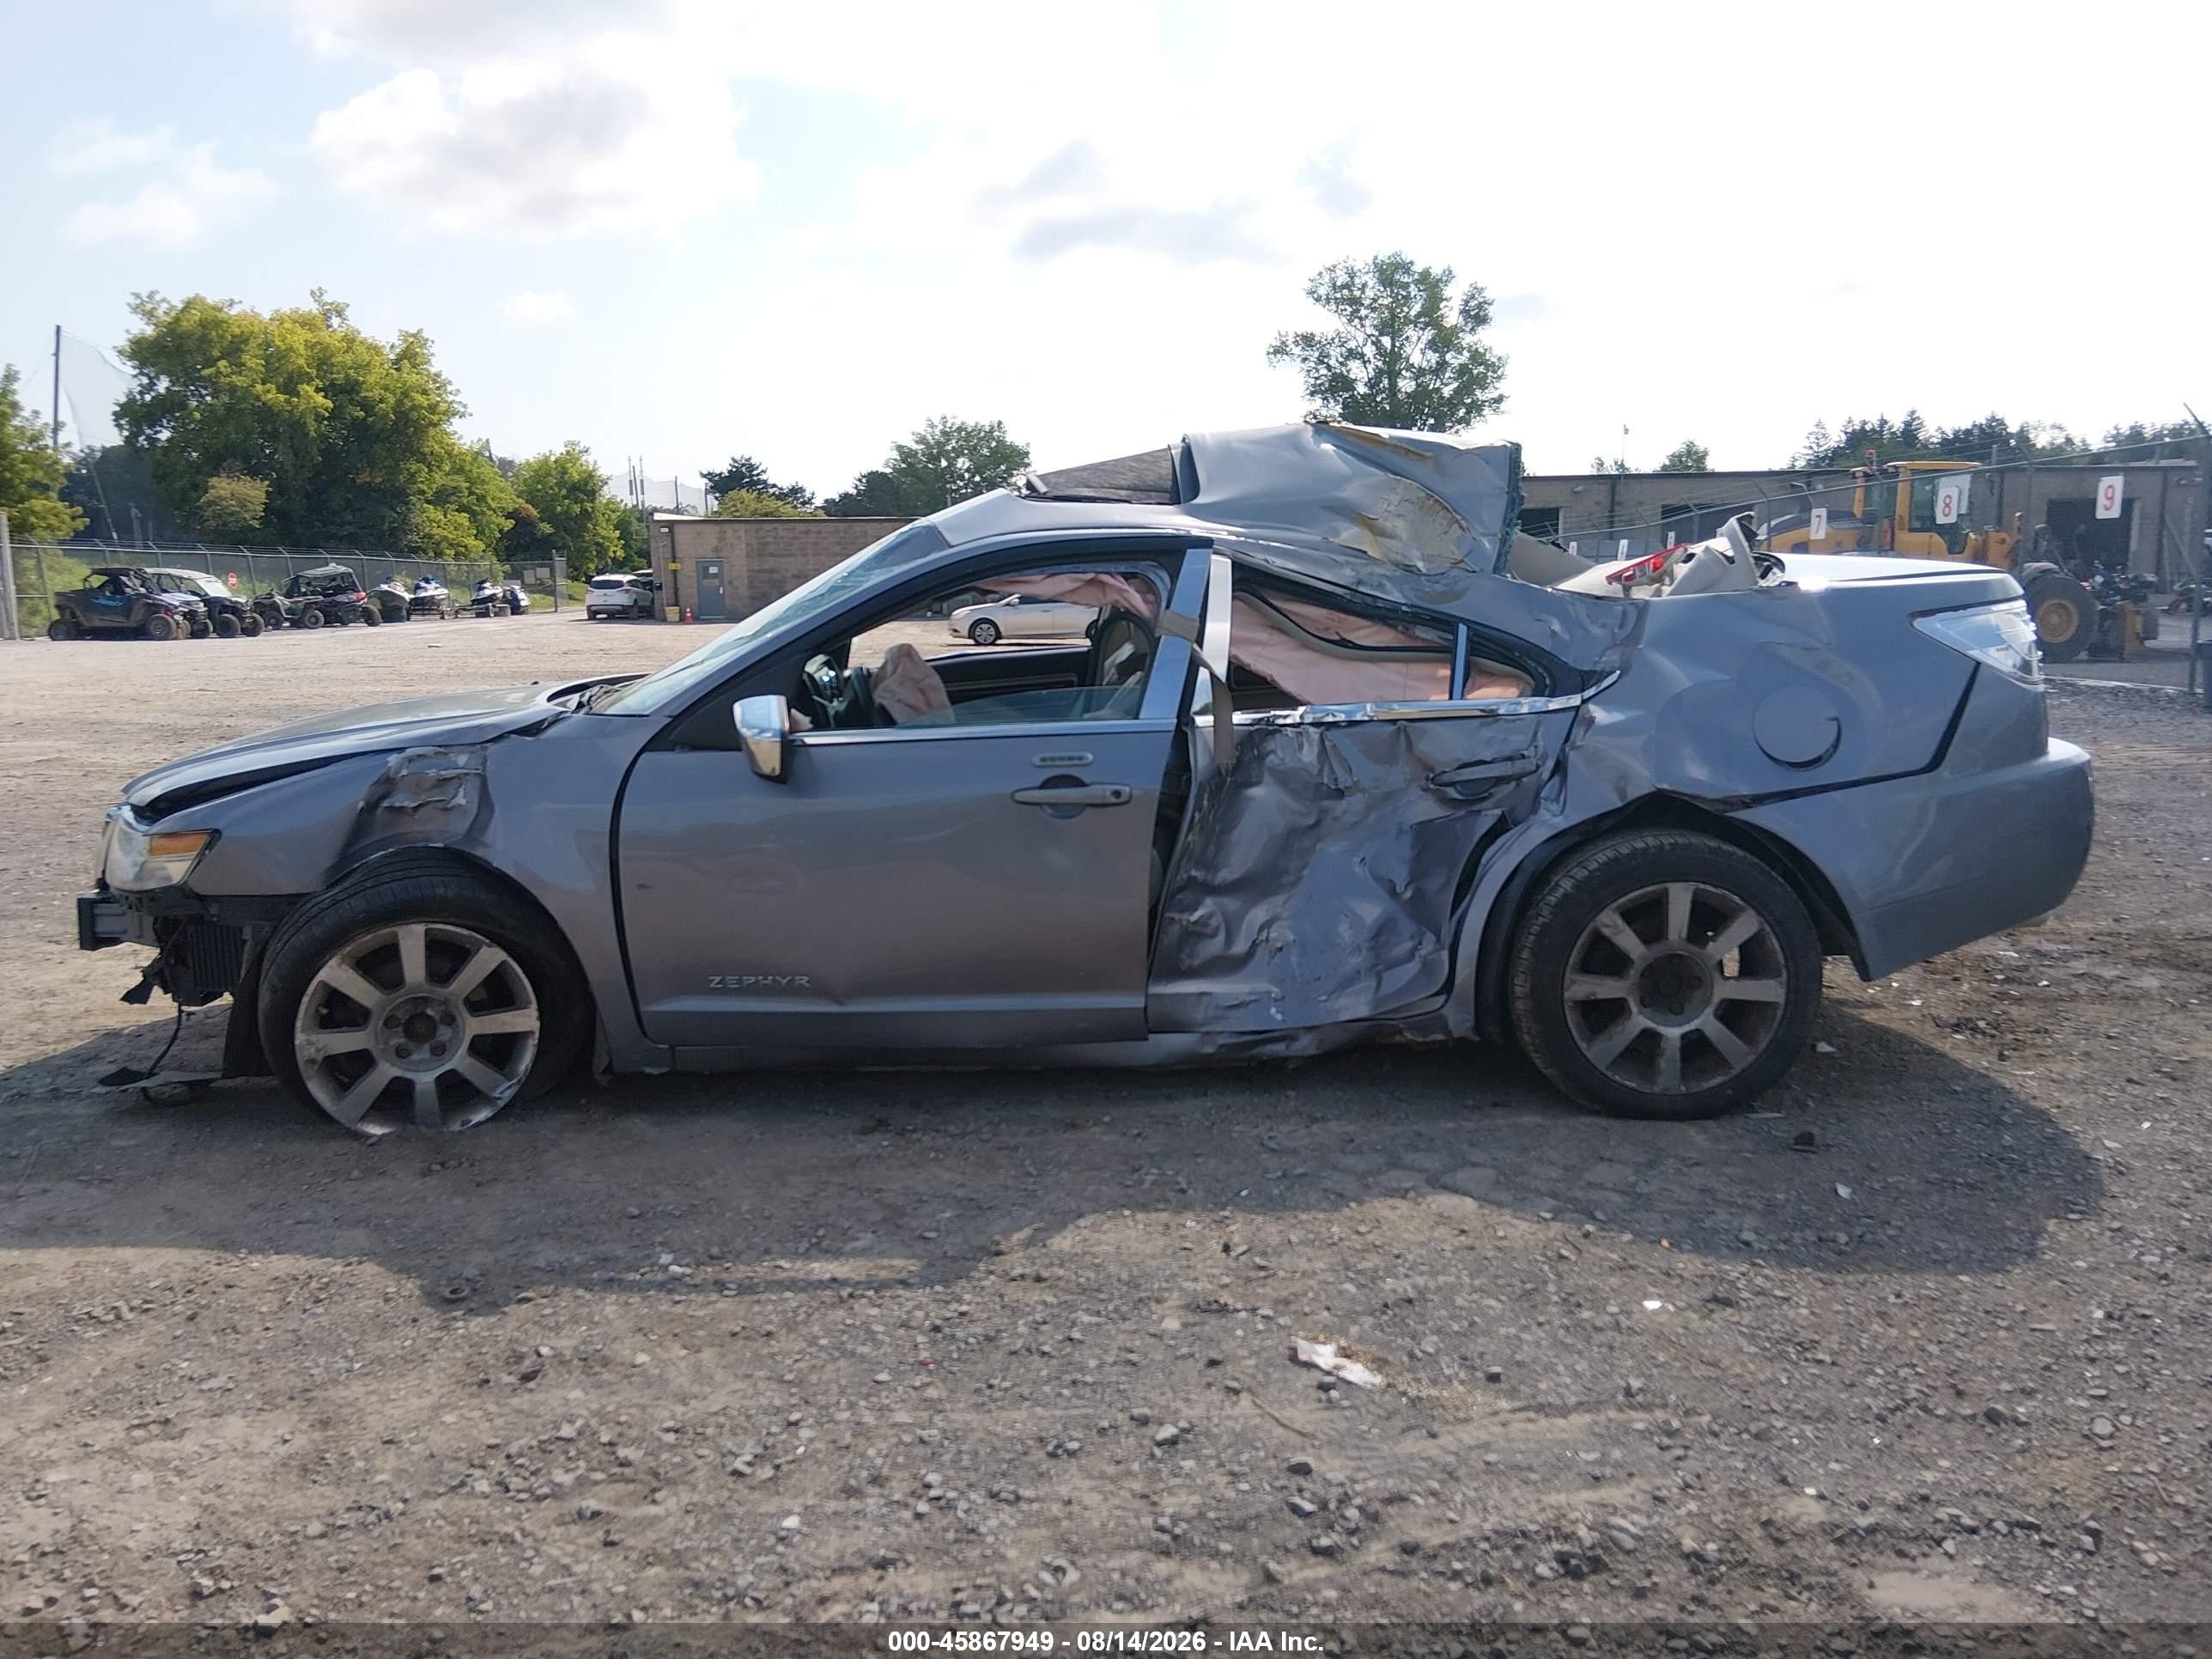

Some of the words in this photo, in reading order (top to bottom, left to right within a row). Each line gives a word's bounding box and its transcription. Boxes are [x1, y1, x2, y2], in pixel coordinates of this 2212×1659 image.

[1942, 495, 1952, 518] 8
[2104, 484, 2115, 511] 9
[1814, 514, 1822, 535] 7
[708, 975, 811, 988] ZEPHYR
